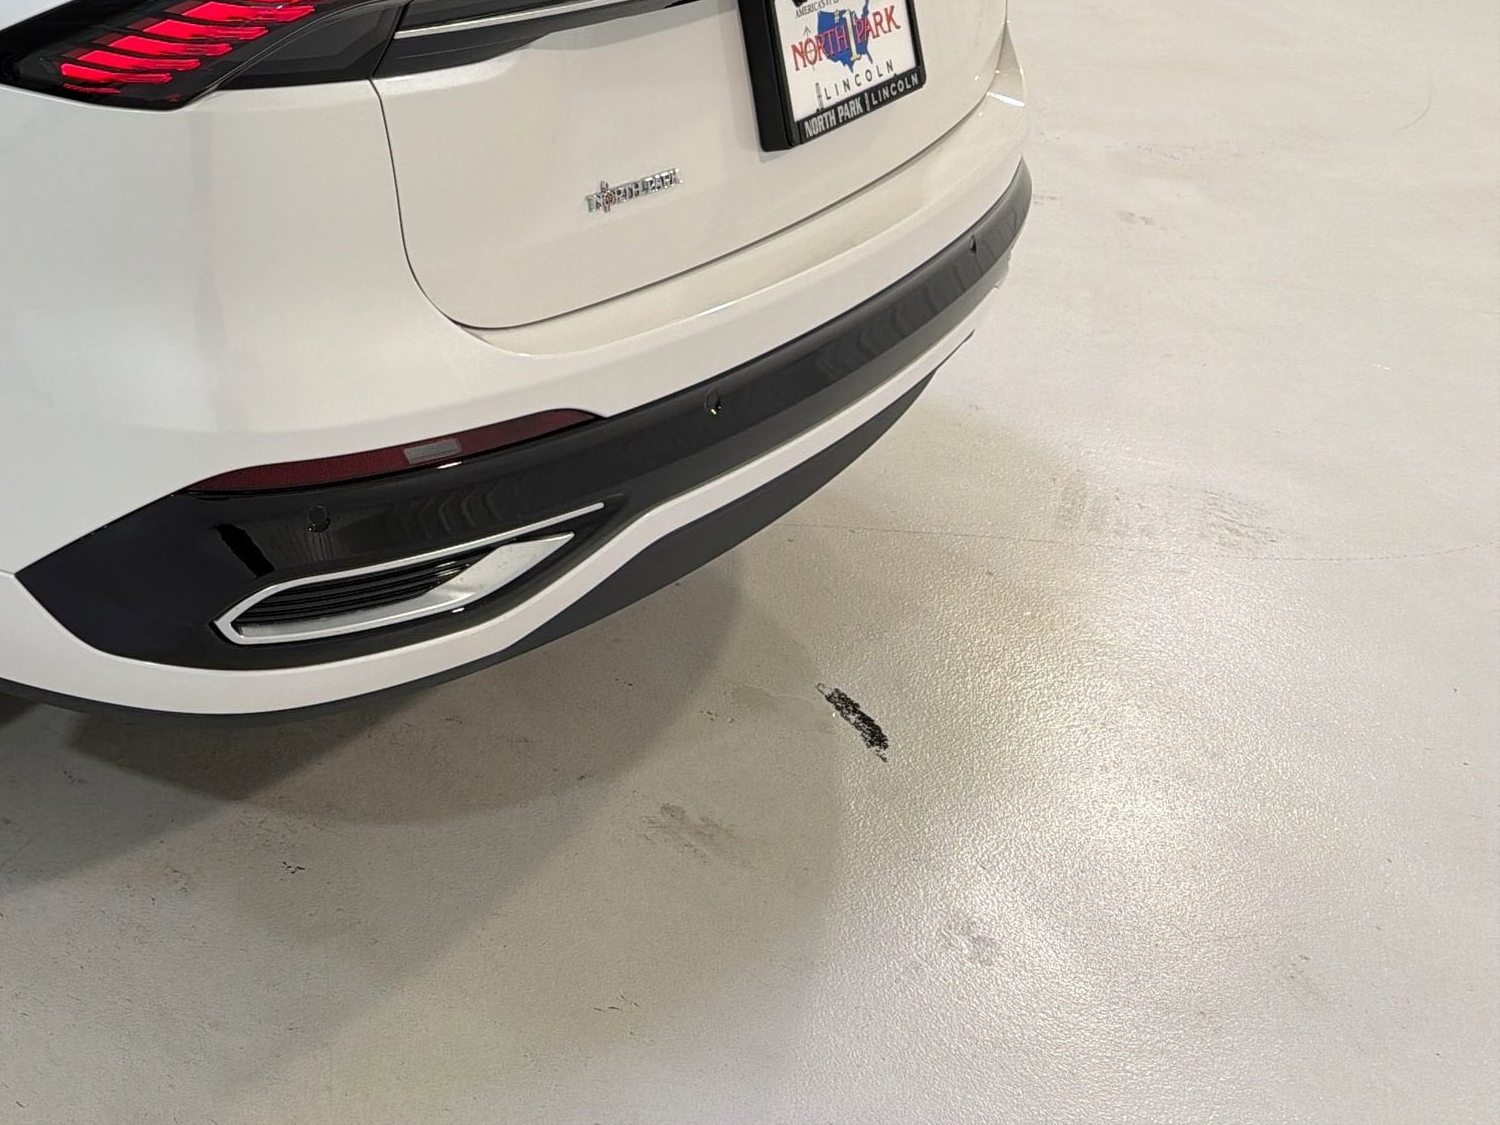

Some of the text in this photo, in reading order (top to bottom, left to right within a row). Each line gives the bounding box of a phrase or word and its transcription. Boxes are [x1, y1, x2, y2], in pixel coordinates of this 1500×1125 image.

[790, 5, 904, 72] NORTH PARK
[804, 72, 920, 140] NORTH PARK LINCOLN
[824, 59, 894, 101] LINCOLN
